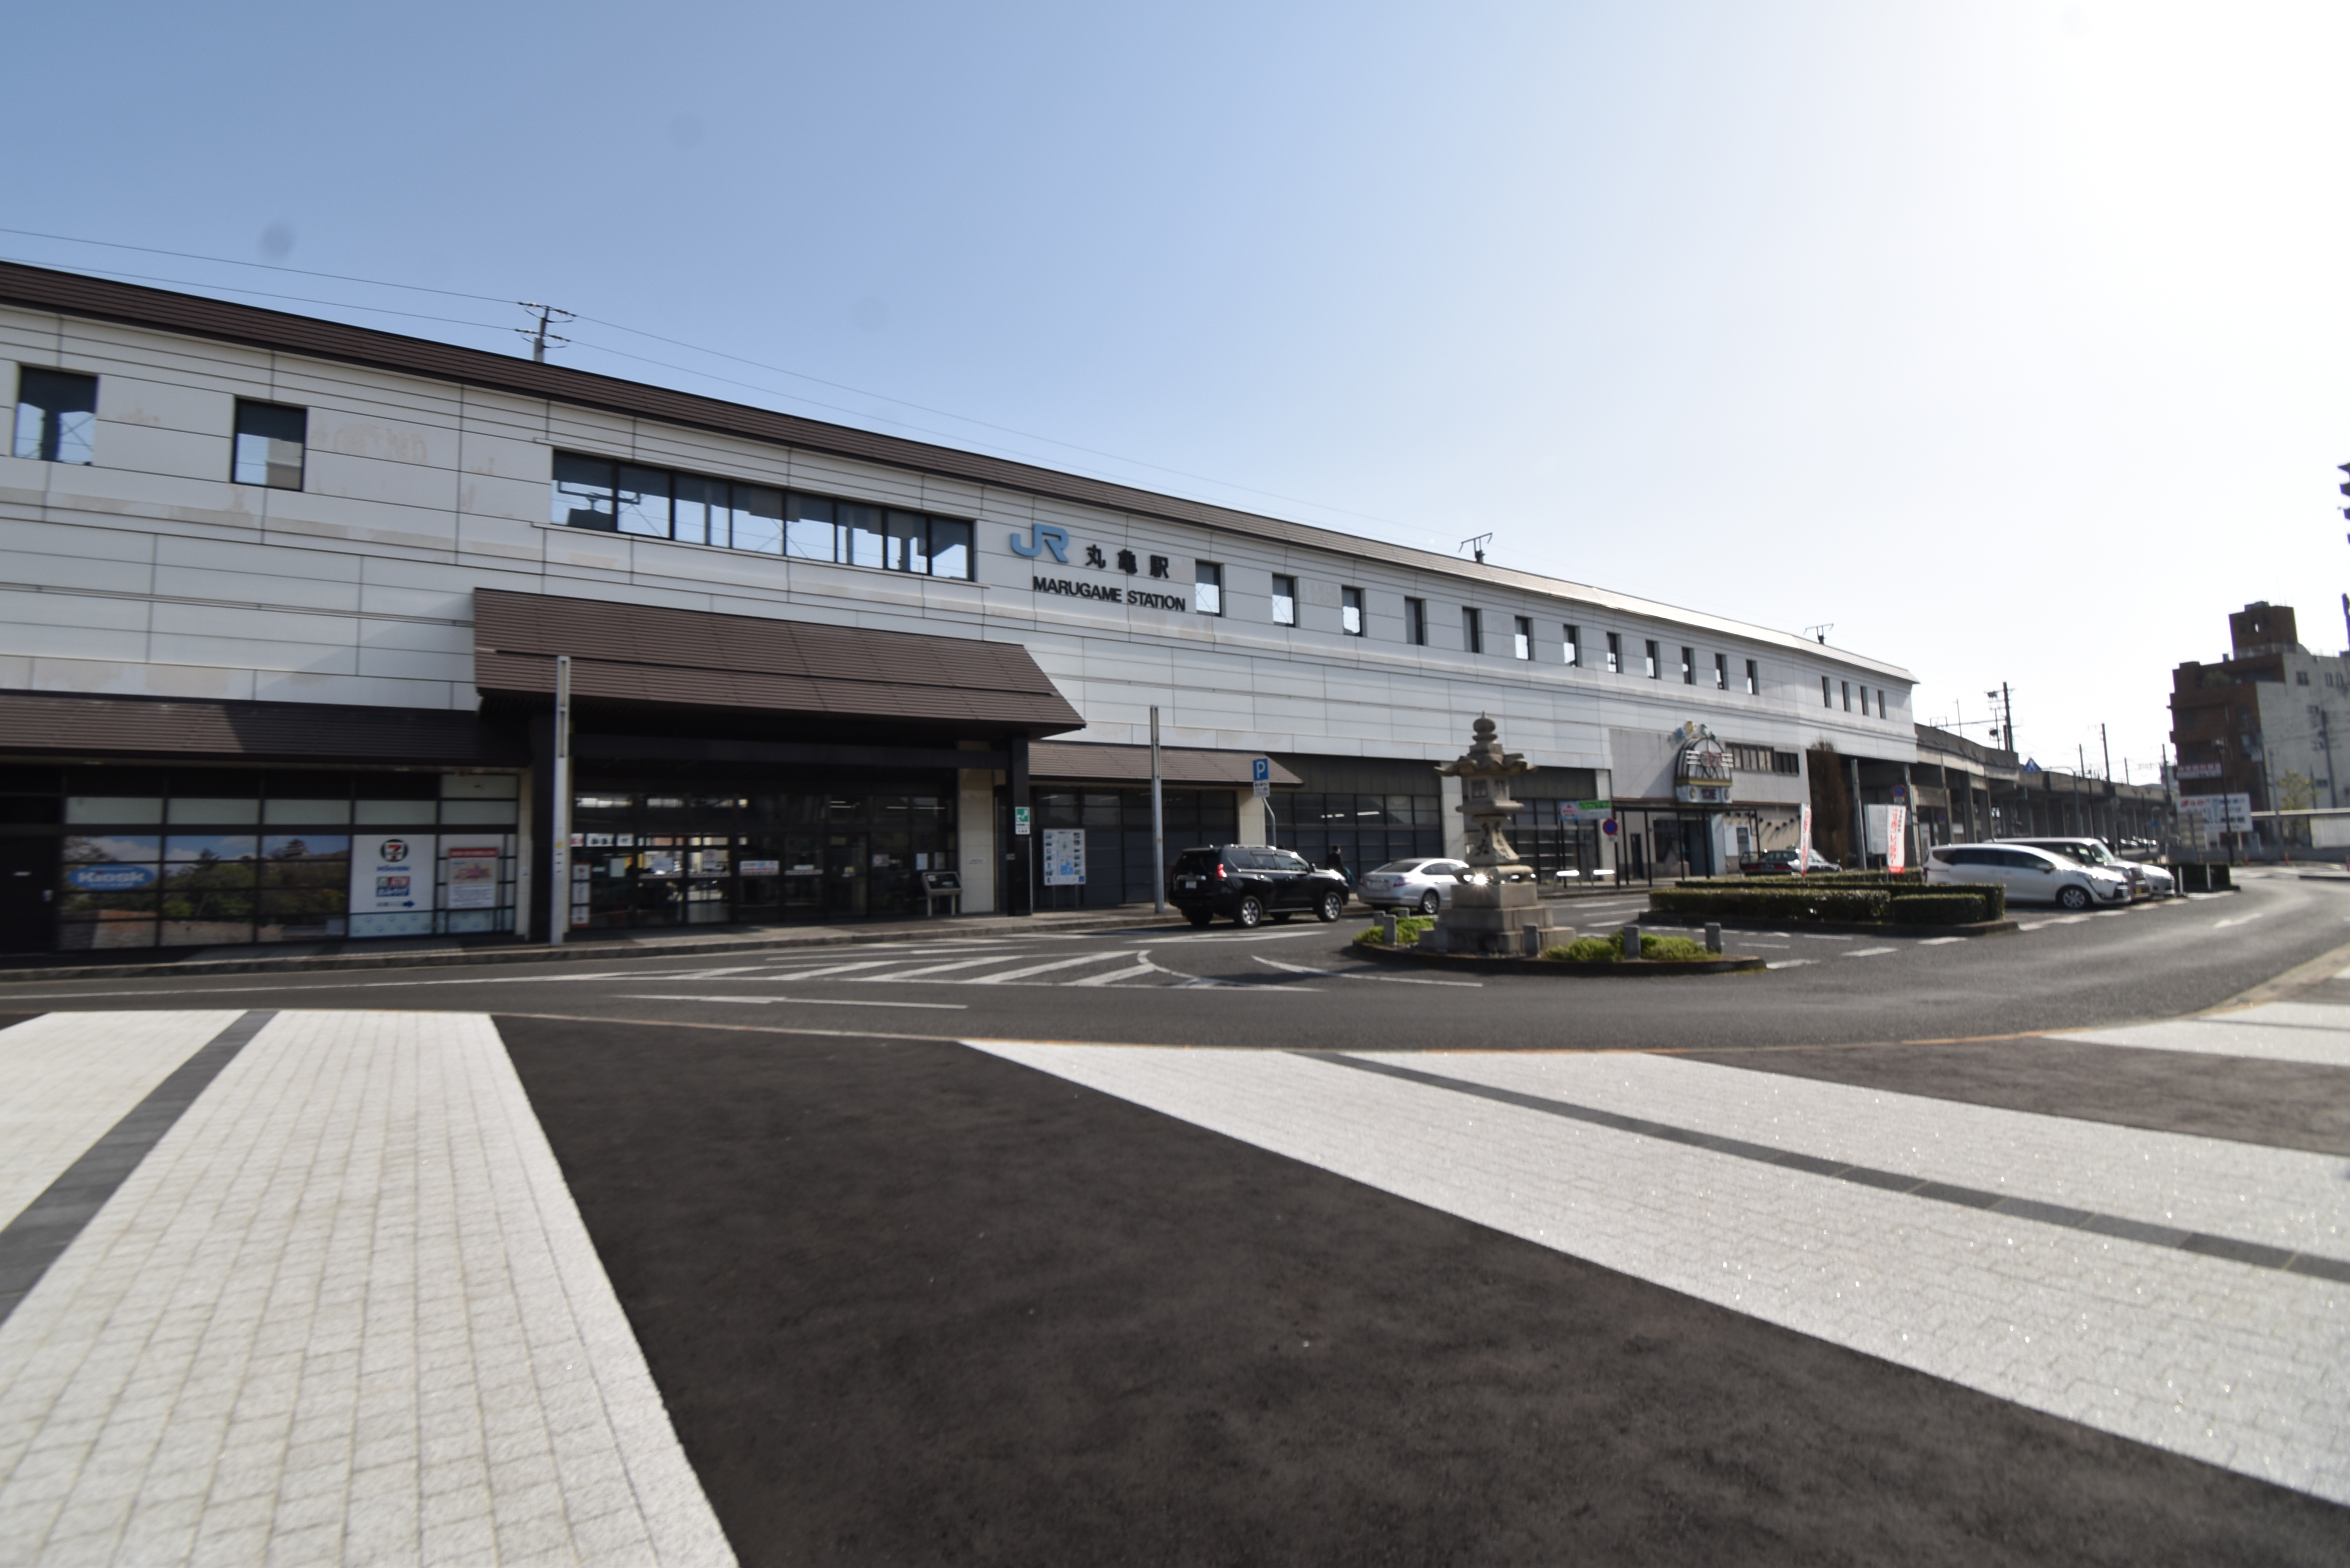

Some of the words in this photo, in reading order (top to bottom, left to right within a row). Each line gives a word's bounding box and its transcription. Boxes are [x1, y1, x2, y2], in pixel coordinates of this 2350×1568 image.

[1010, 523, 1069, 563] JR
[1085, 544, 1170, 579] 丸亀駅
[1033, 576, 1122, 603] MARUGAME
[1127, 590, 1186, 612] STATION
[1257, 761, 1266, 779] P
[78, 871, 145, 883] Kiosk
